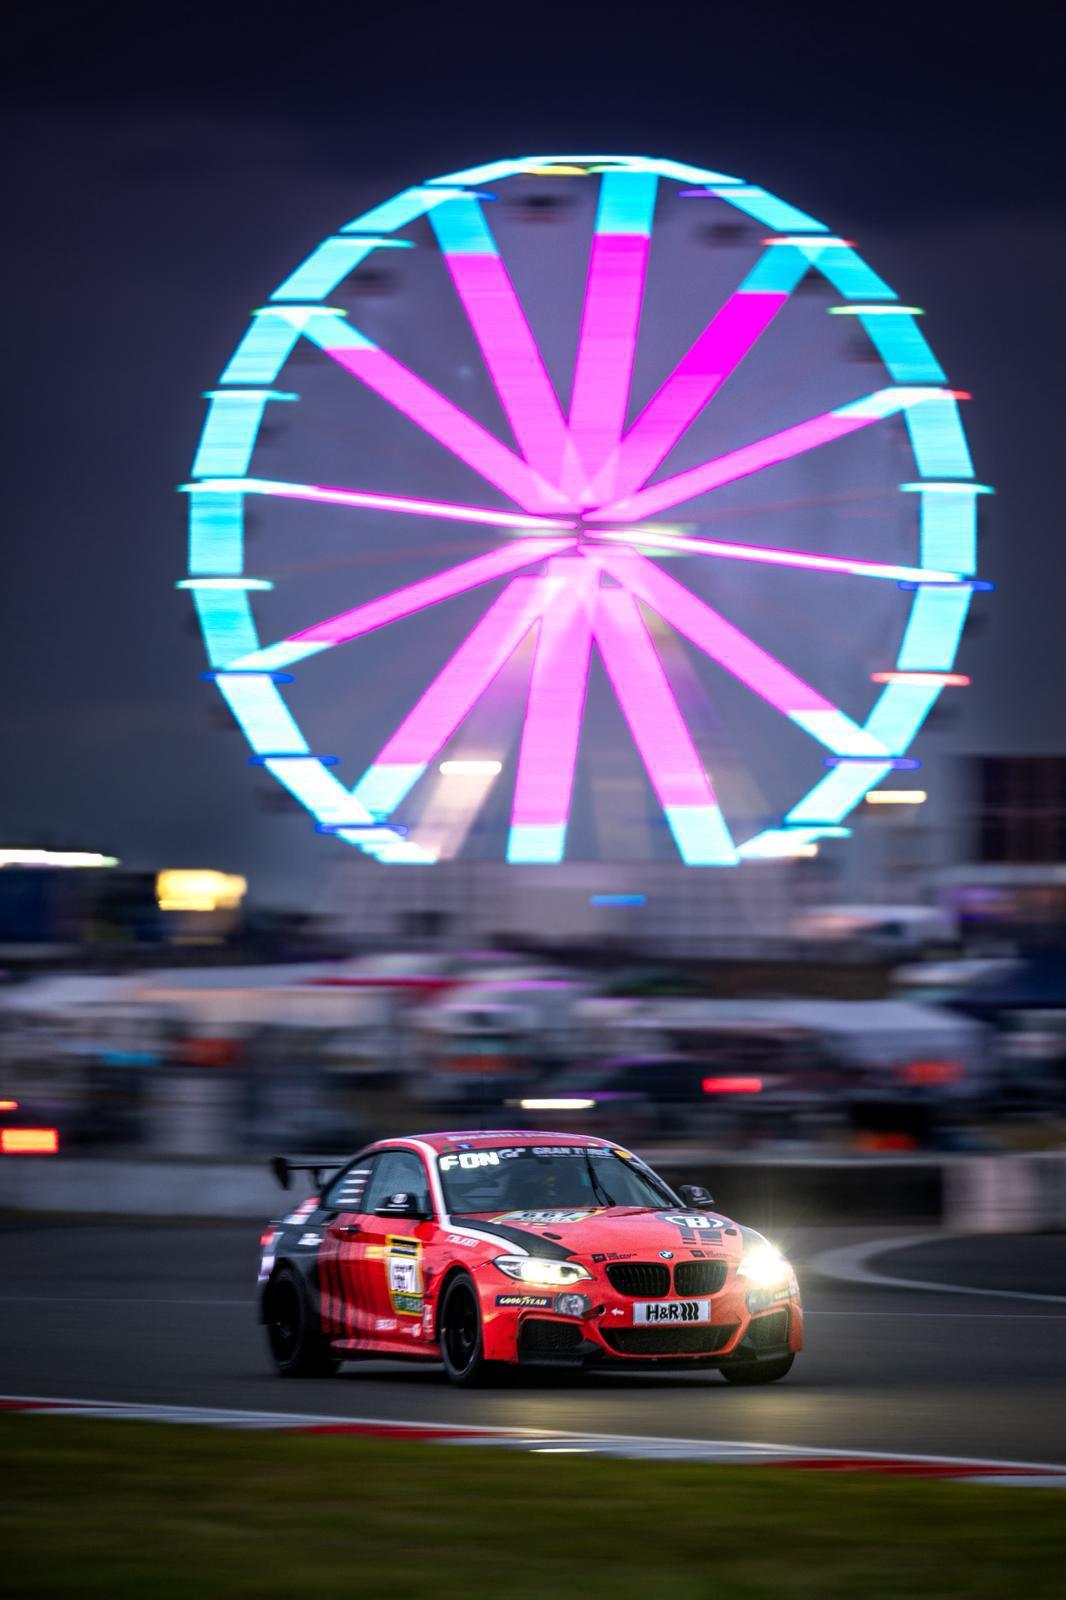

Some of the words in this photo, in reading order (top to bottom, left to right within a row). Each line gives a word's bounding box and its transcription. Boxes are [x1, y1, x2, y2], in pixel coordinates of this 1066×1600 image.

[532, 1147, 571, 1155] GRAN
[439, 1151, 500, 1171] FON
[646, 1303, 679, 1321] H&R
